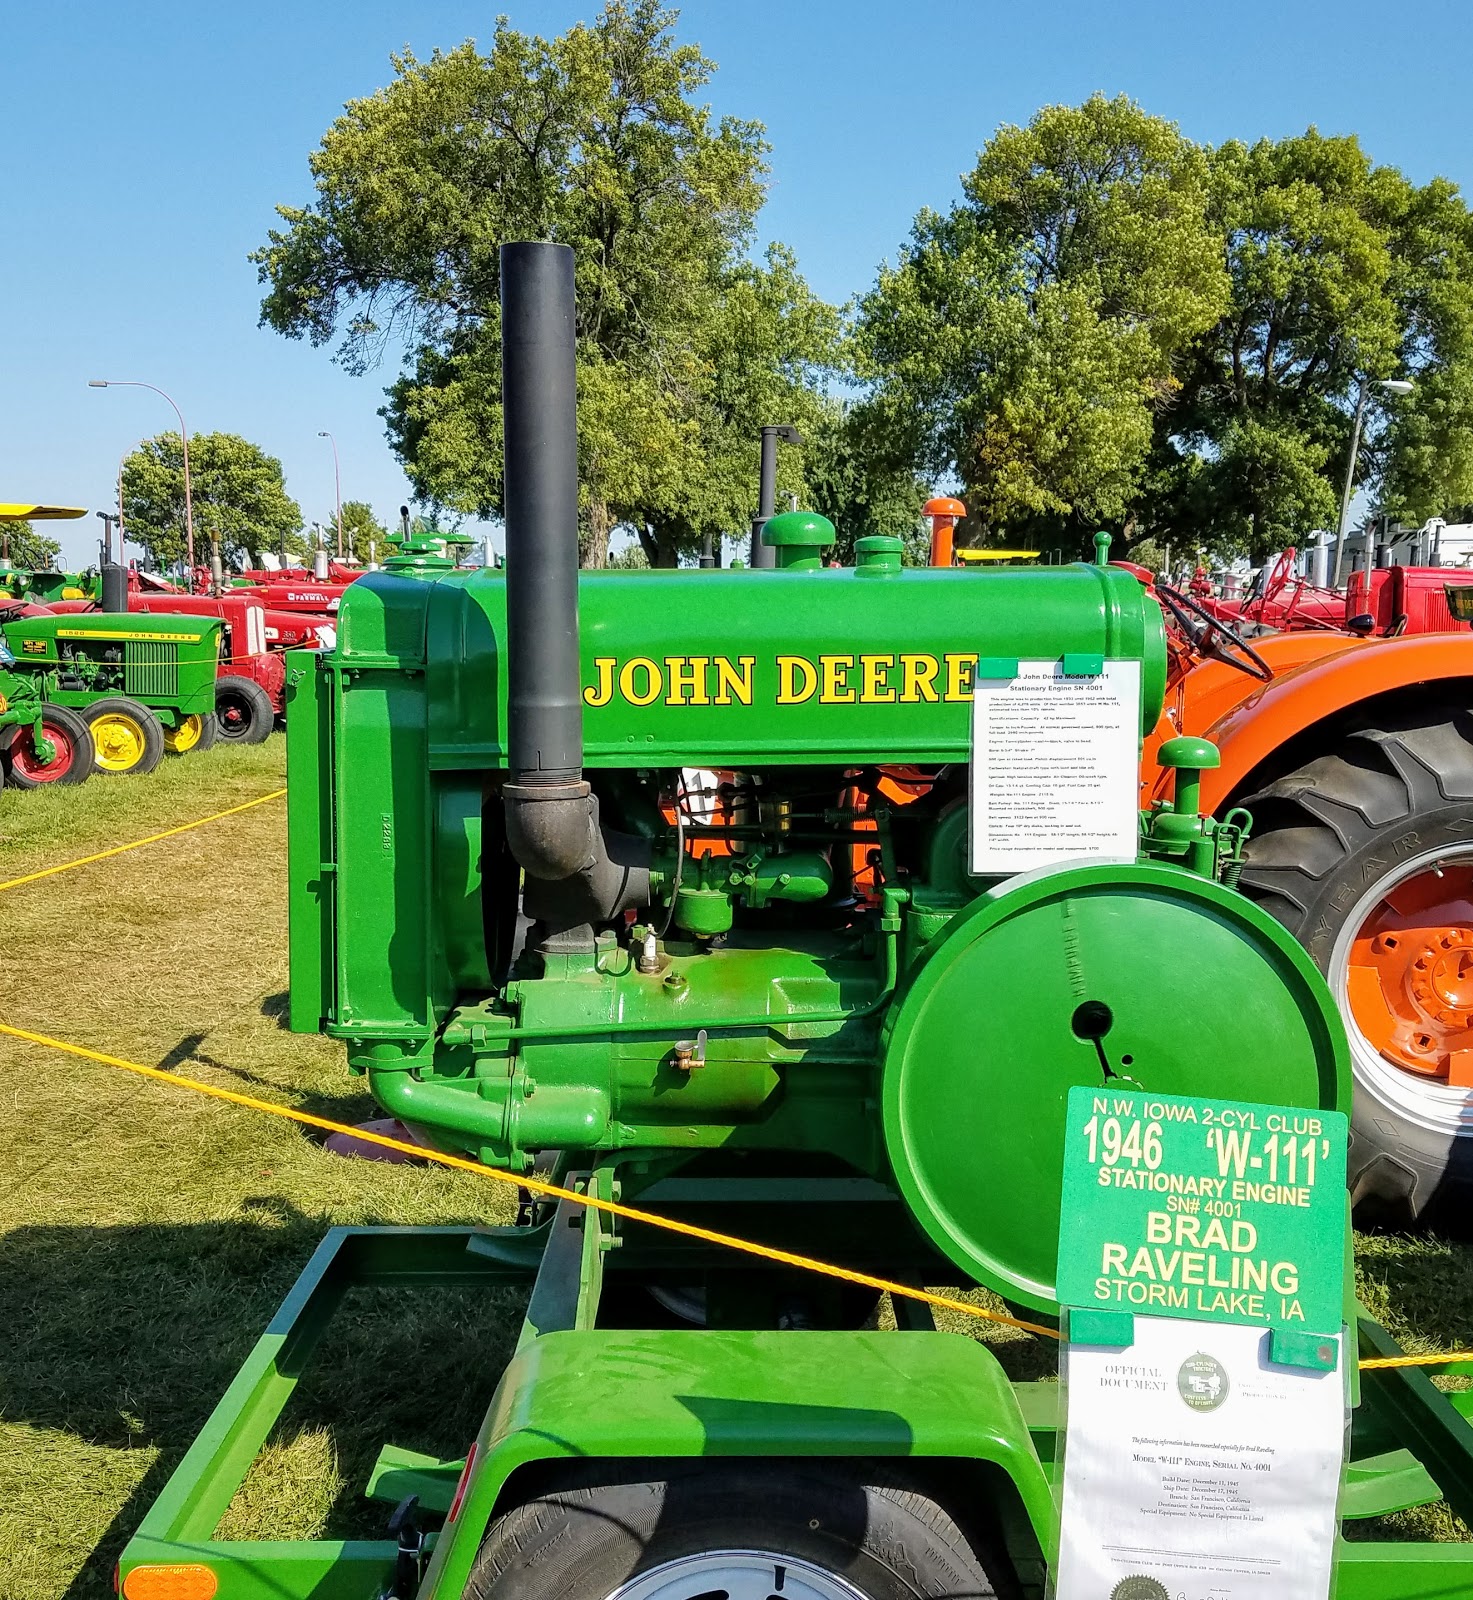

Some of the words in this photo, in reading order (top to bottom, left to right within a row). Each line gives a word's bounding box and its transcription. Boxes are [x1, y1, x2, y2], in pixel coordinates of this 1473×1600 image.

[583, 656, 756, 708] JOHN
[776, 653, 979, 705] DEERE
[1093, 1097, 1136, 1117] N.W.
[1143, 1102, 1197, 1124] IOWA
[1202, 1108, 1261, 1130] 2-CYL
[1266, 1114, 1322, 1136] CLUB
[1083, 1116, 1163, 1170] 1946
[1098, 1167, 1226, 1198] STATIONARY
[1232, 1181, 1311, 1207] ENGINE
[1166, 1195, 1200, 1214] SN#
[1204, 1200, 1242, 1219] 4001
[1147, 1212, 1258, 1253] BRAD
[1102, 1243, 1299, 1295] RAVELING
[1095, 1278, 1188, 1308] STORM
[1197, 1289, 1272, 1322] LAKE,
[1281, 1299, 1305, 1322] IA
[1100, 1377, 1169, 1391] DOCUMENT
[1105, 1365, 1162, 1377] OFFICIAL
[1213, 1460, 1238, 1470] SERIAL
[1254, 1463, 1271, 1471] 4001
[1163, 1484, 1175, 1492] Ship
[1192, 1478, 1218, 1486] December
[1201, 1495, 1225, 1503] Francisco,
